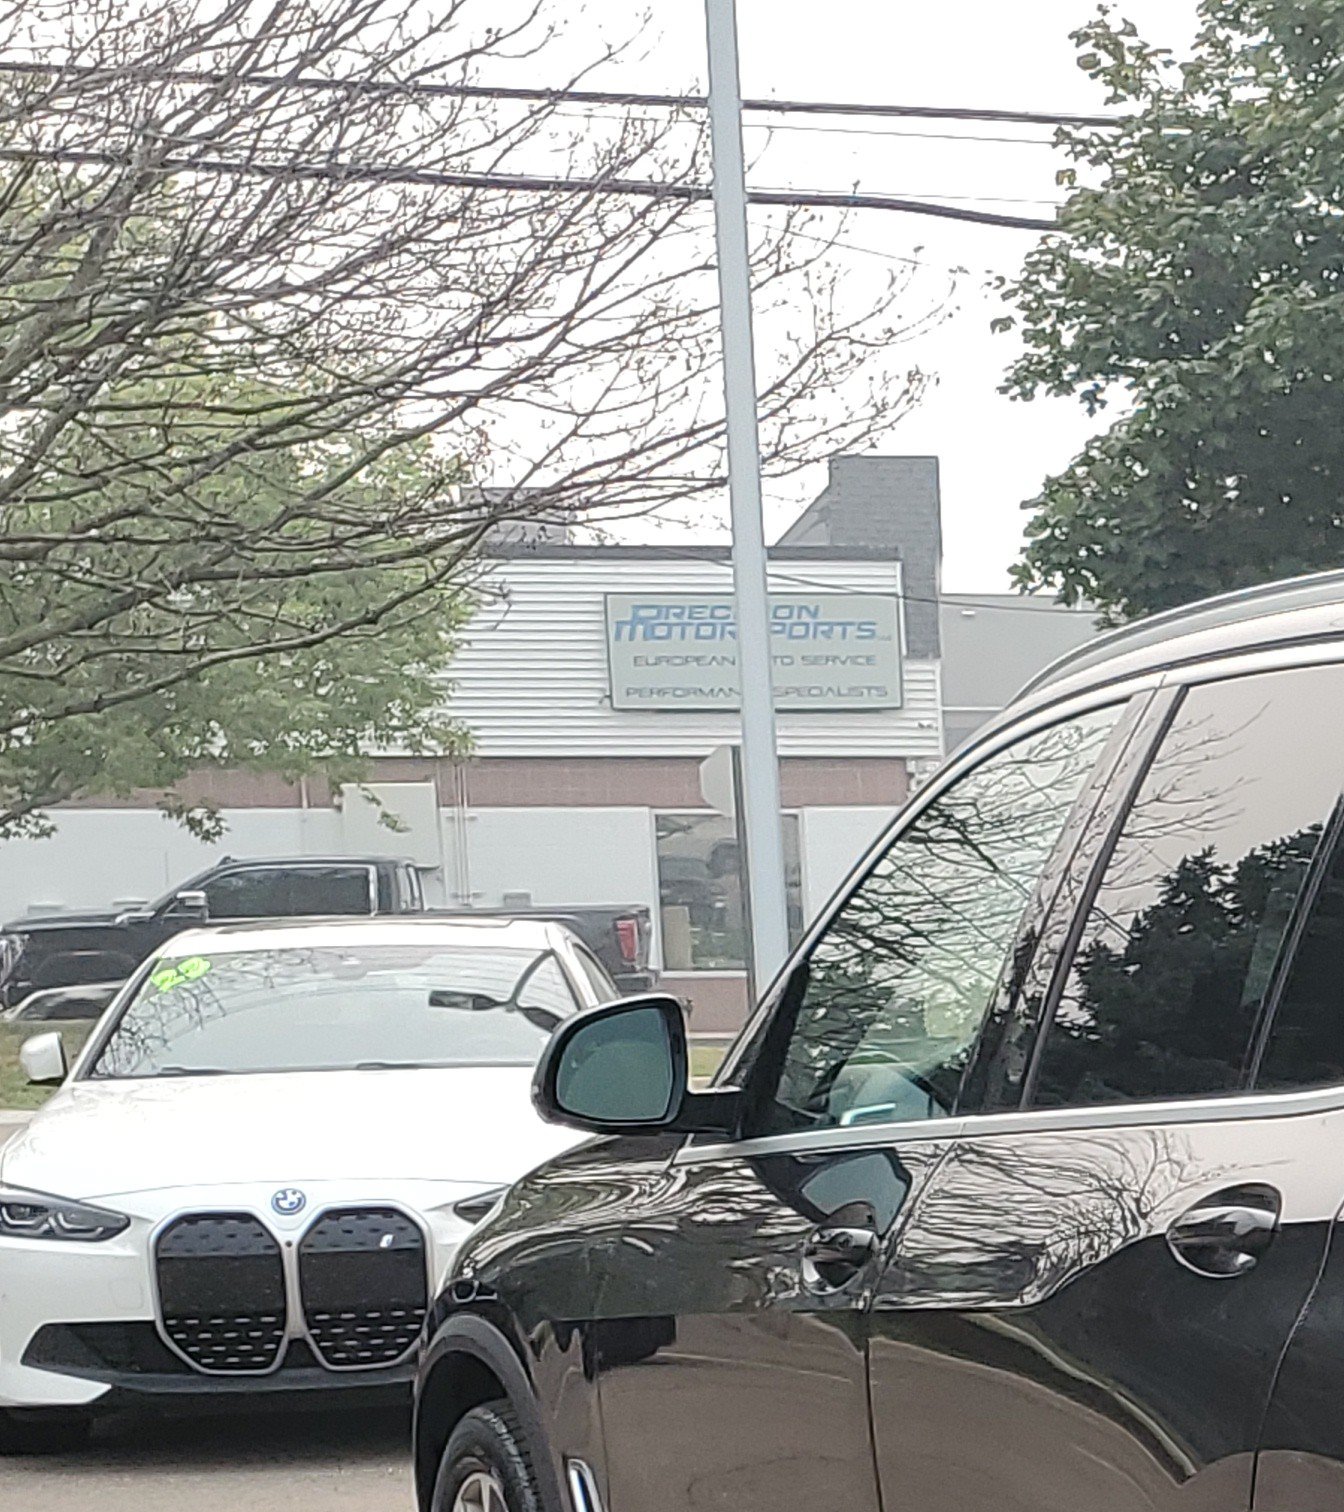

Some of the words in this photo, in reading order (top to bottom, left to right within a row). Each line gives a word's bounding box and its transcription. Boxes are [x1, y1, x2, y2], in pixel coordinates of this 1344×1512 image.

[631, 604, 820, 621] PRECON
[614, 620, 877, 642] MOTORPORTS
[633, 654, 737, 667] EUROPEAN
[801, 654, 877, 667] SERVICE
